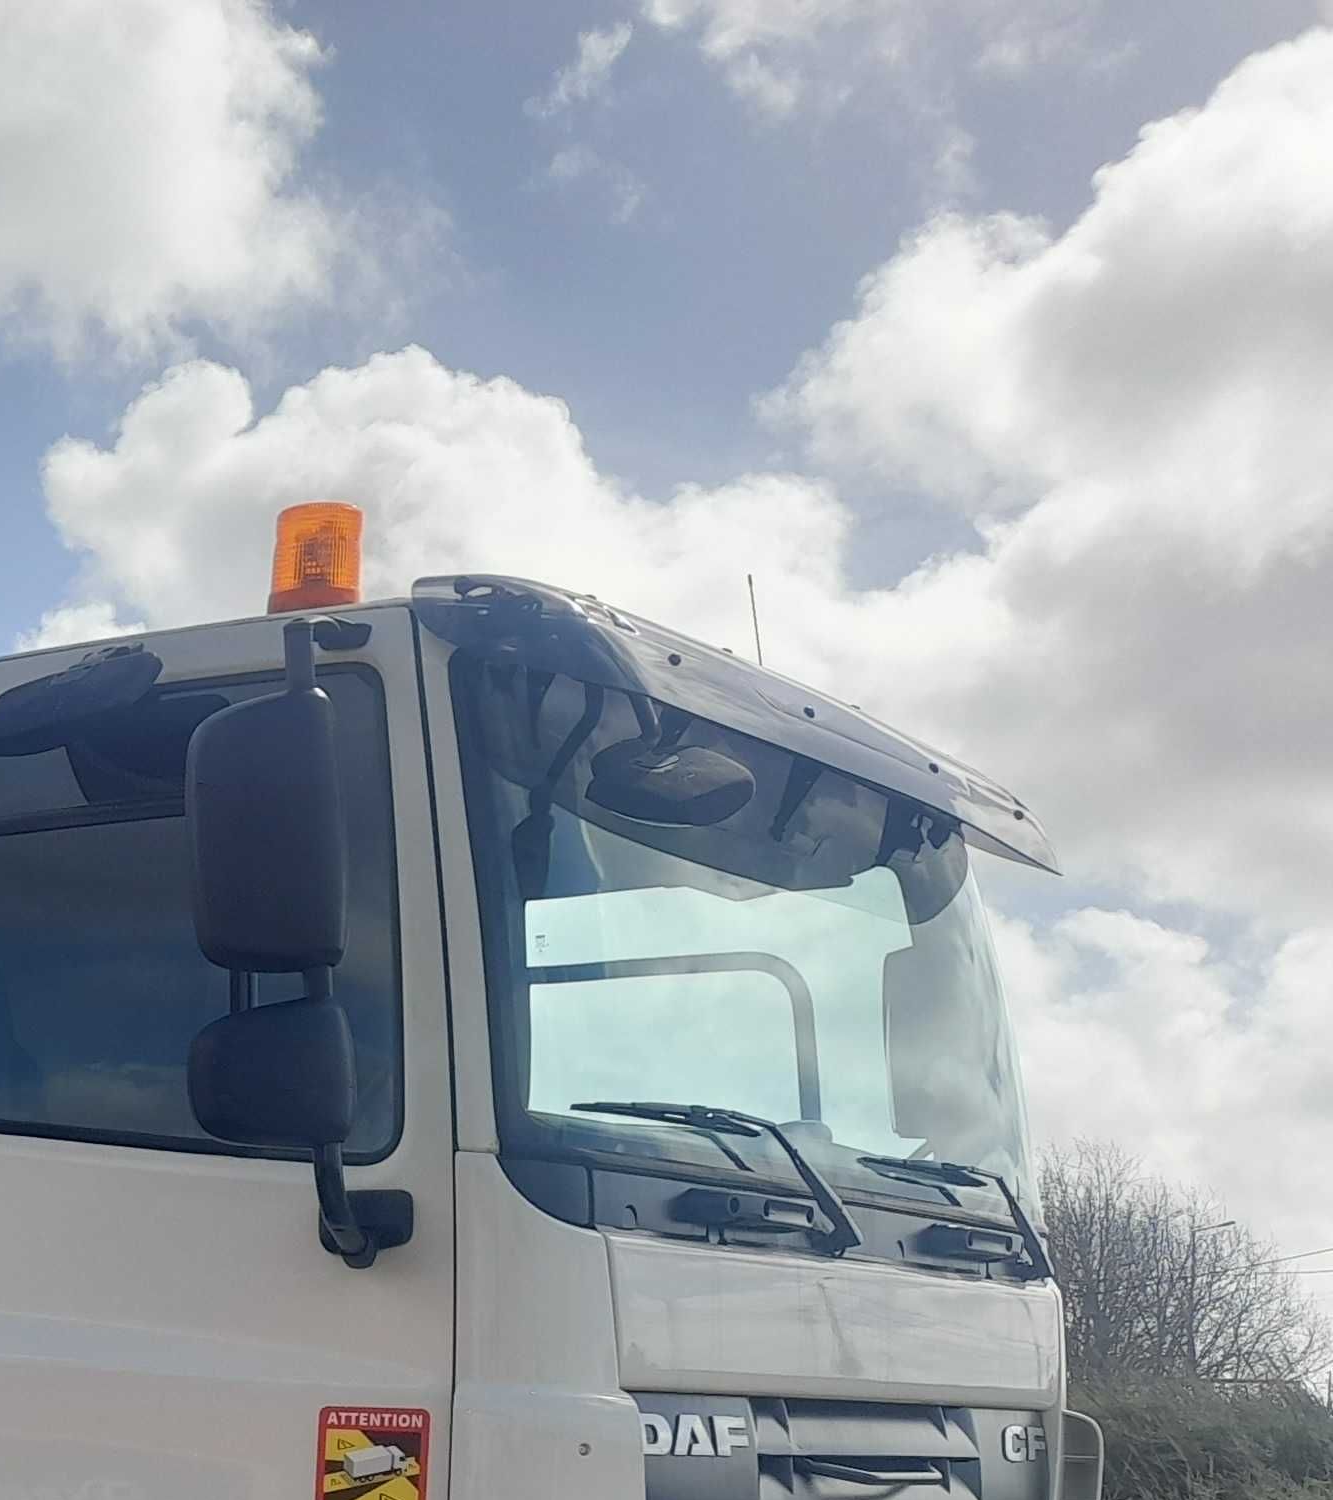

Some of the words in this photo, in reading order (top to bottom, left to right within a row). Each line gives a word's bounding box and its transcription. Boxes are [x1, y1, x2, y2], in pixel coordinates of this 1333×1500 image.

[327, 1410, 424, 1428] ATTENTION
[638, 1412, 750, 1457] DAF
[1002, 1424, 1046, 1463] CF
